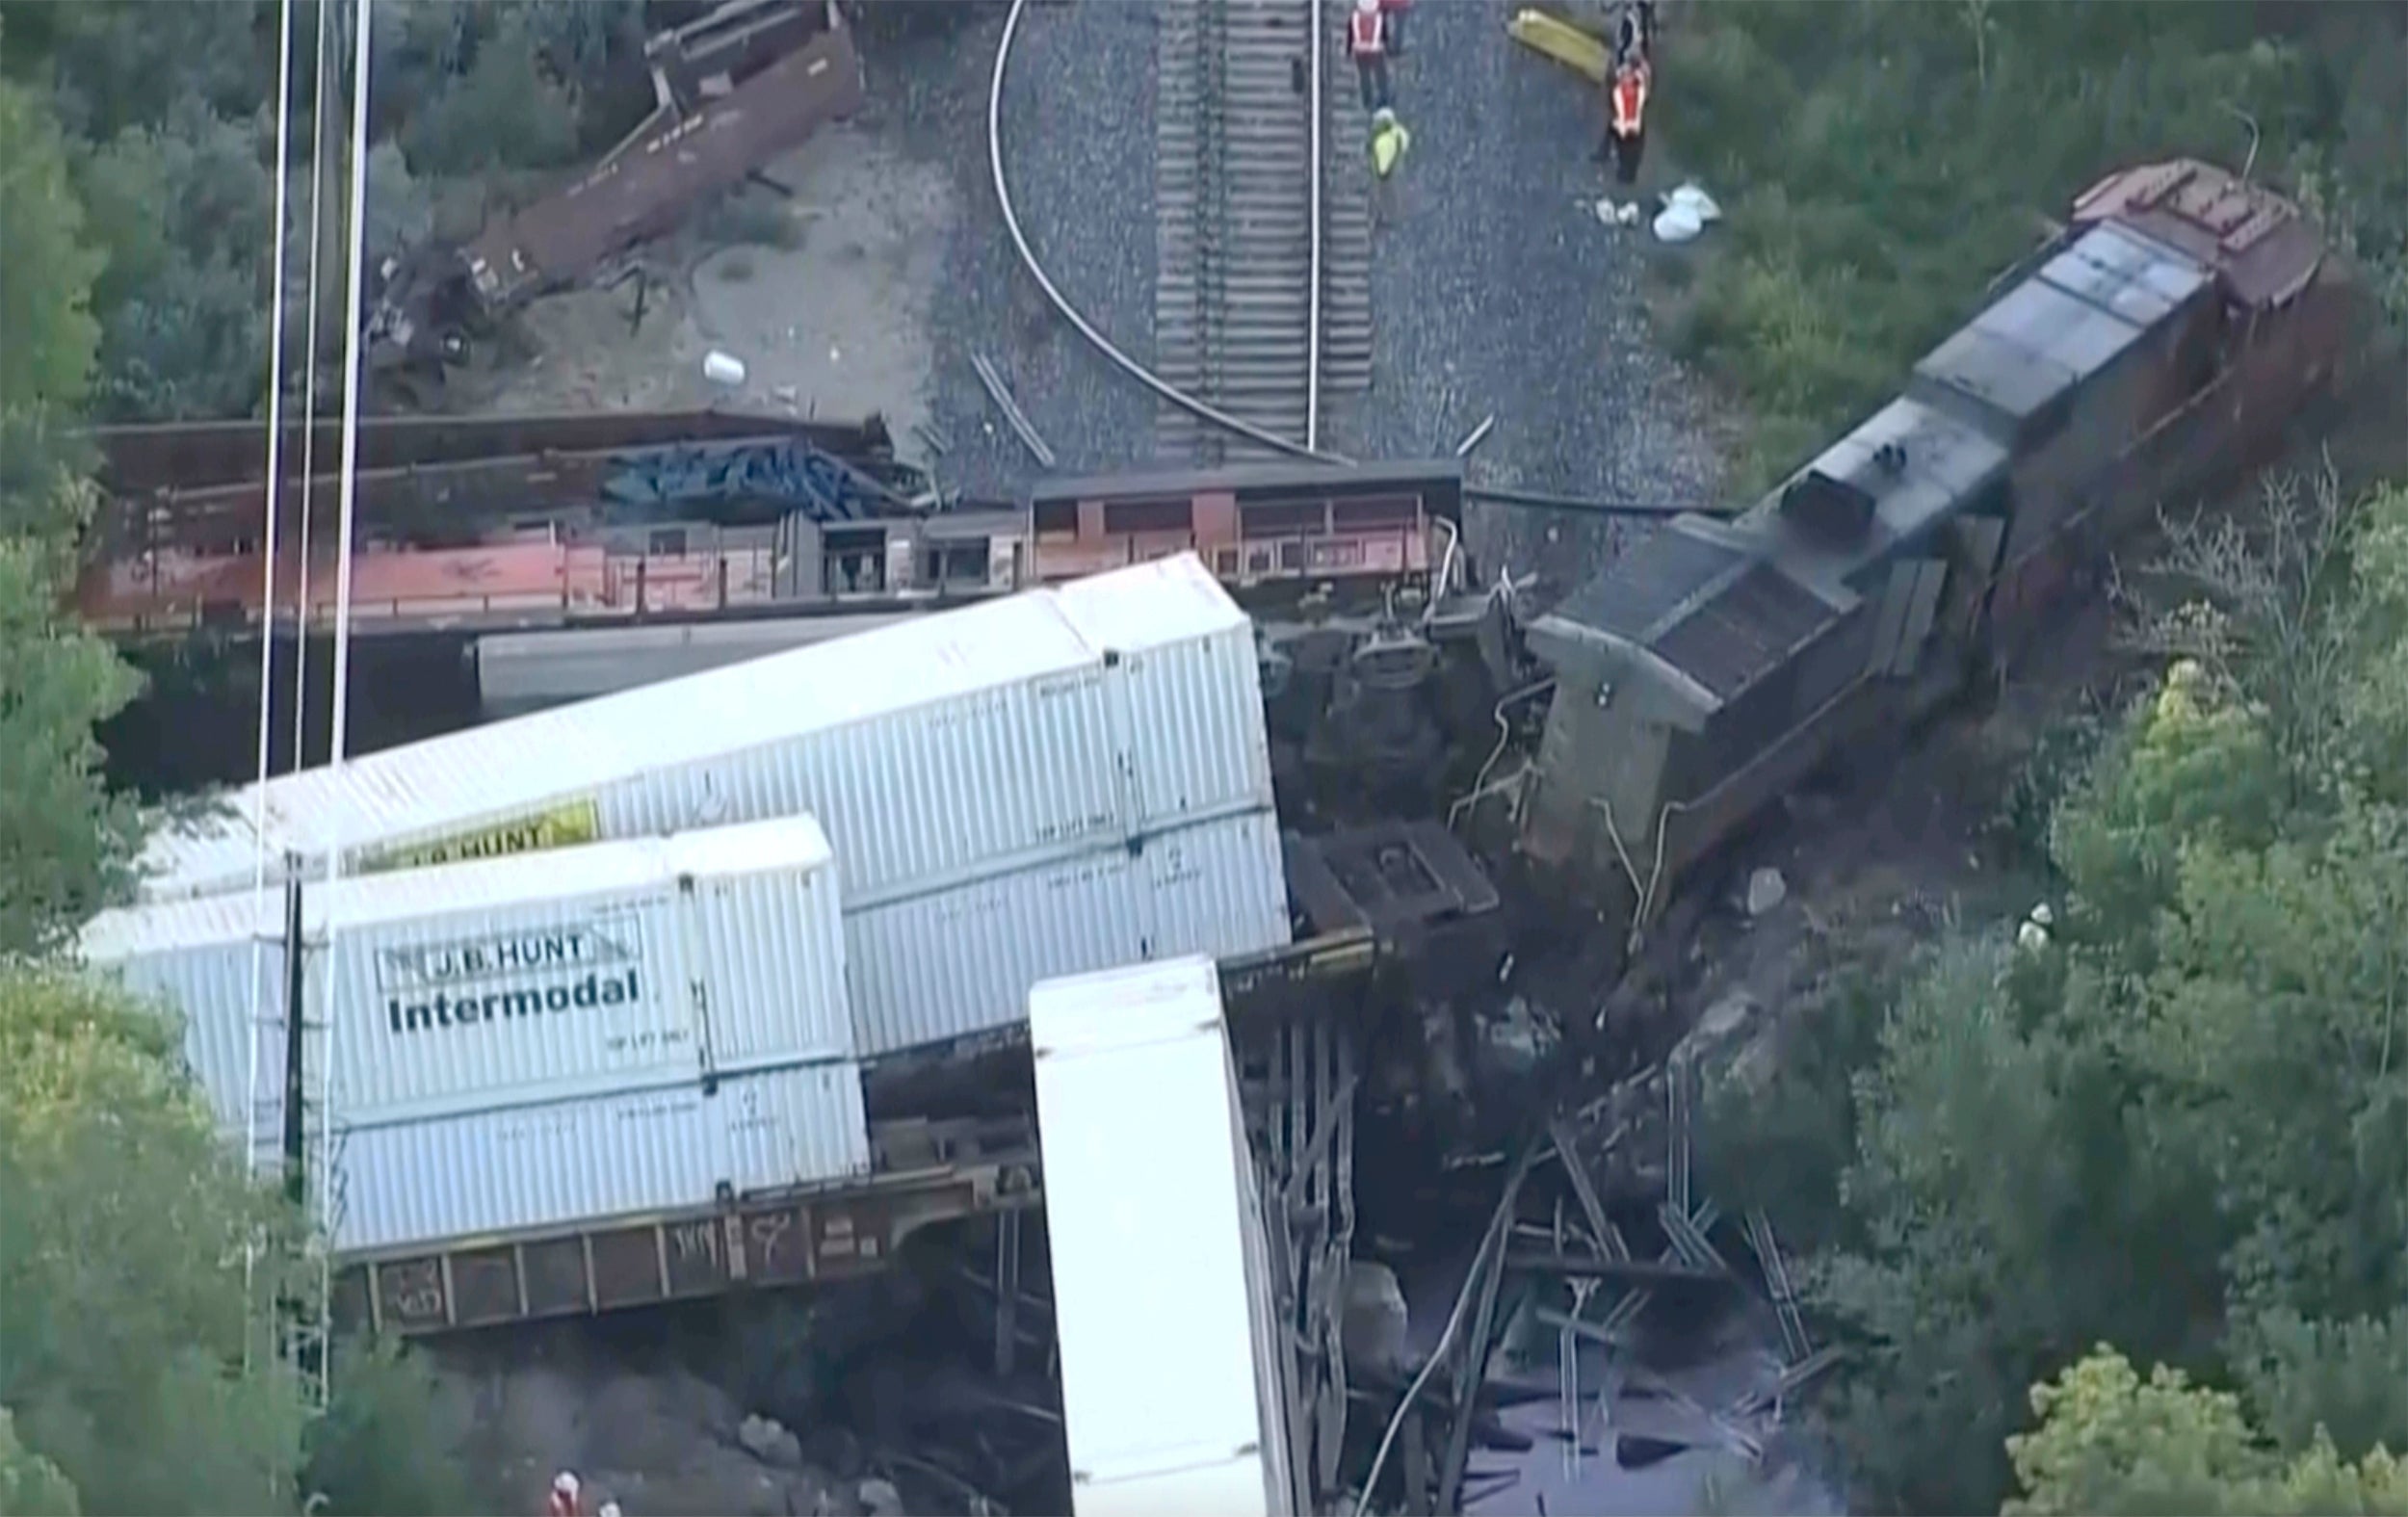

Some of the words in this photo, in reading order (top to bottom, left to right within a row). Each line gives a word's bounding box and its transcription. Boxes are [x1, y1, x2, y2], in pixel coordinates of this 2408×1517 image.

[435, 948, 492, 978] J.B.
[497, 933, 584, 968] HUNT
[388, 967, 640, 1033] Intermodal
